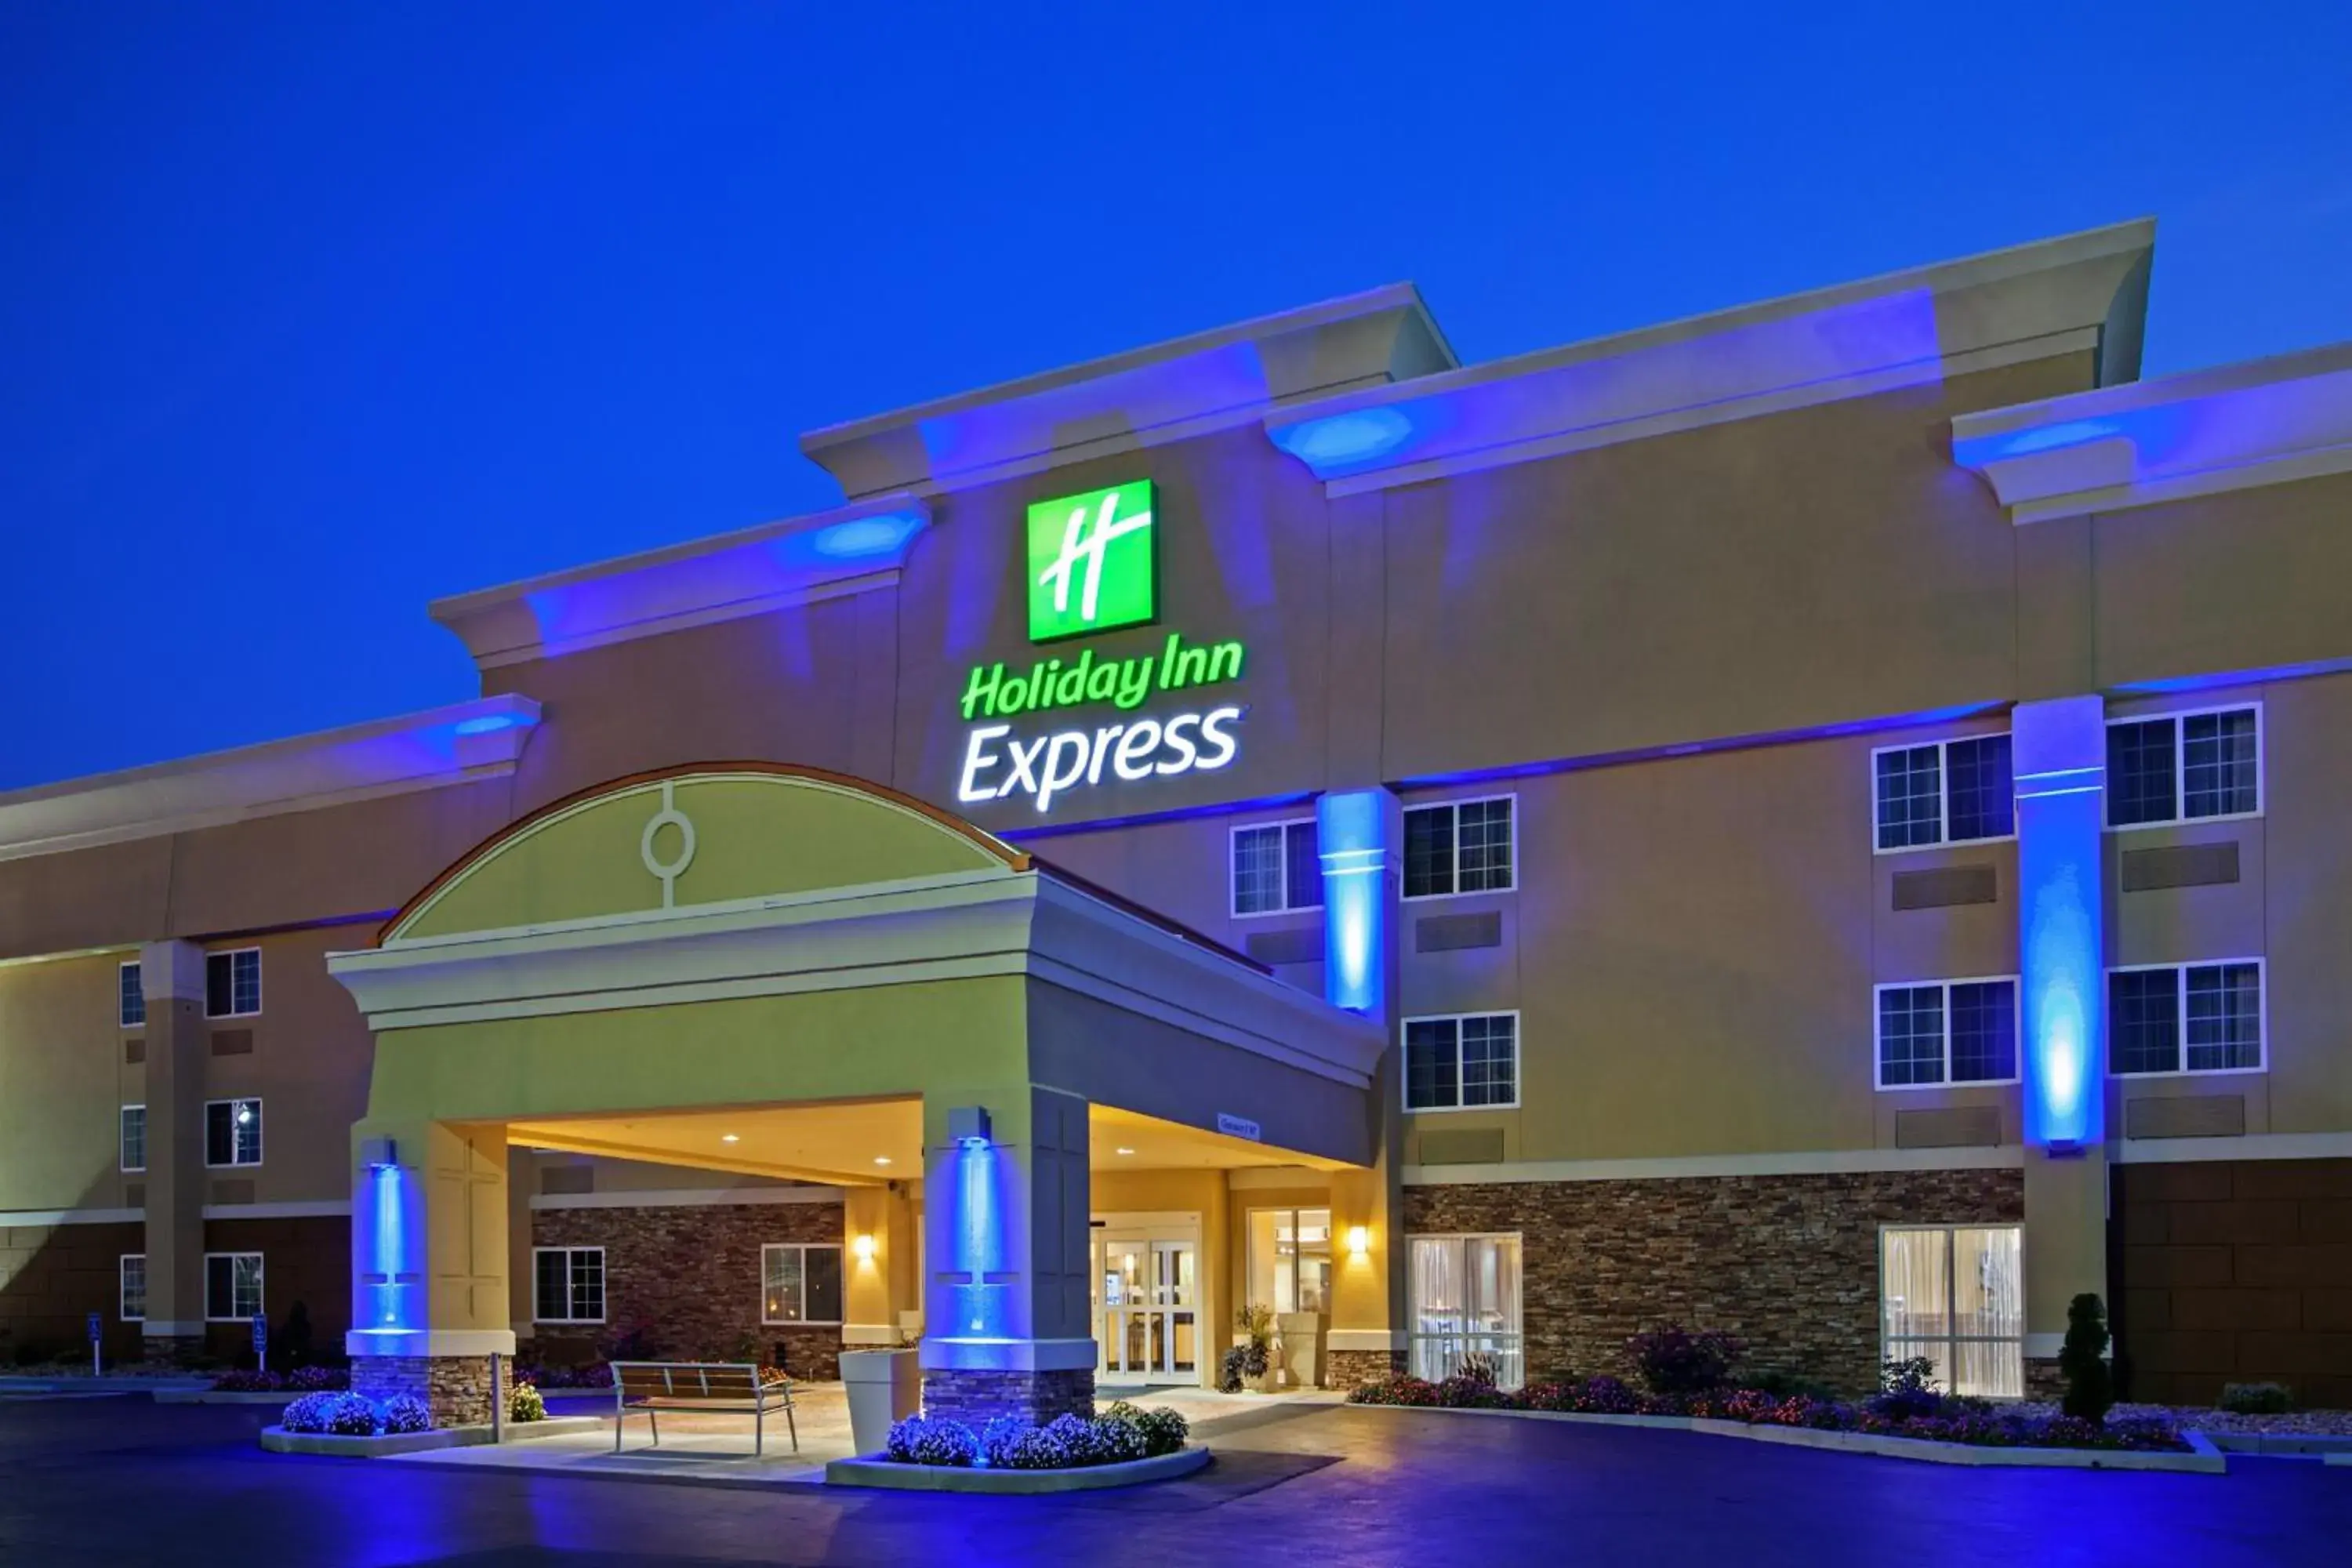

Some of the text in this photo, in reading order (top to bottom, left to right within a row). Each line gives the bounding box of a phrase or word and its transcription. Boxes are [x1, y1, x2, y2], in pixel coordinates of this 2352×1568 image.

[1039, 492, 1151, 620] H
[961, 633, 1243, 719] Holiday Inn
[958, 707, 1241, 812] Express
